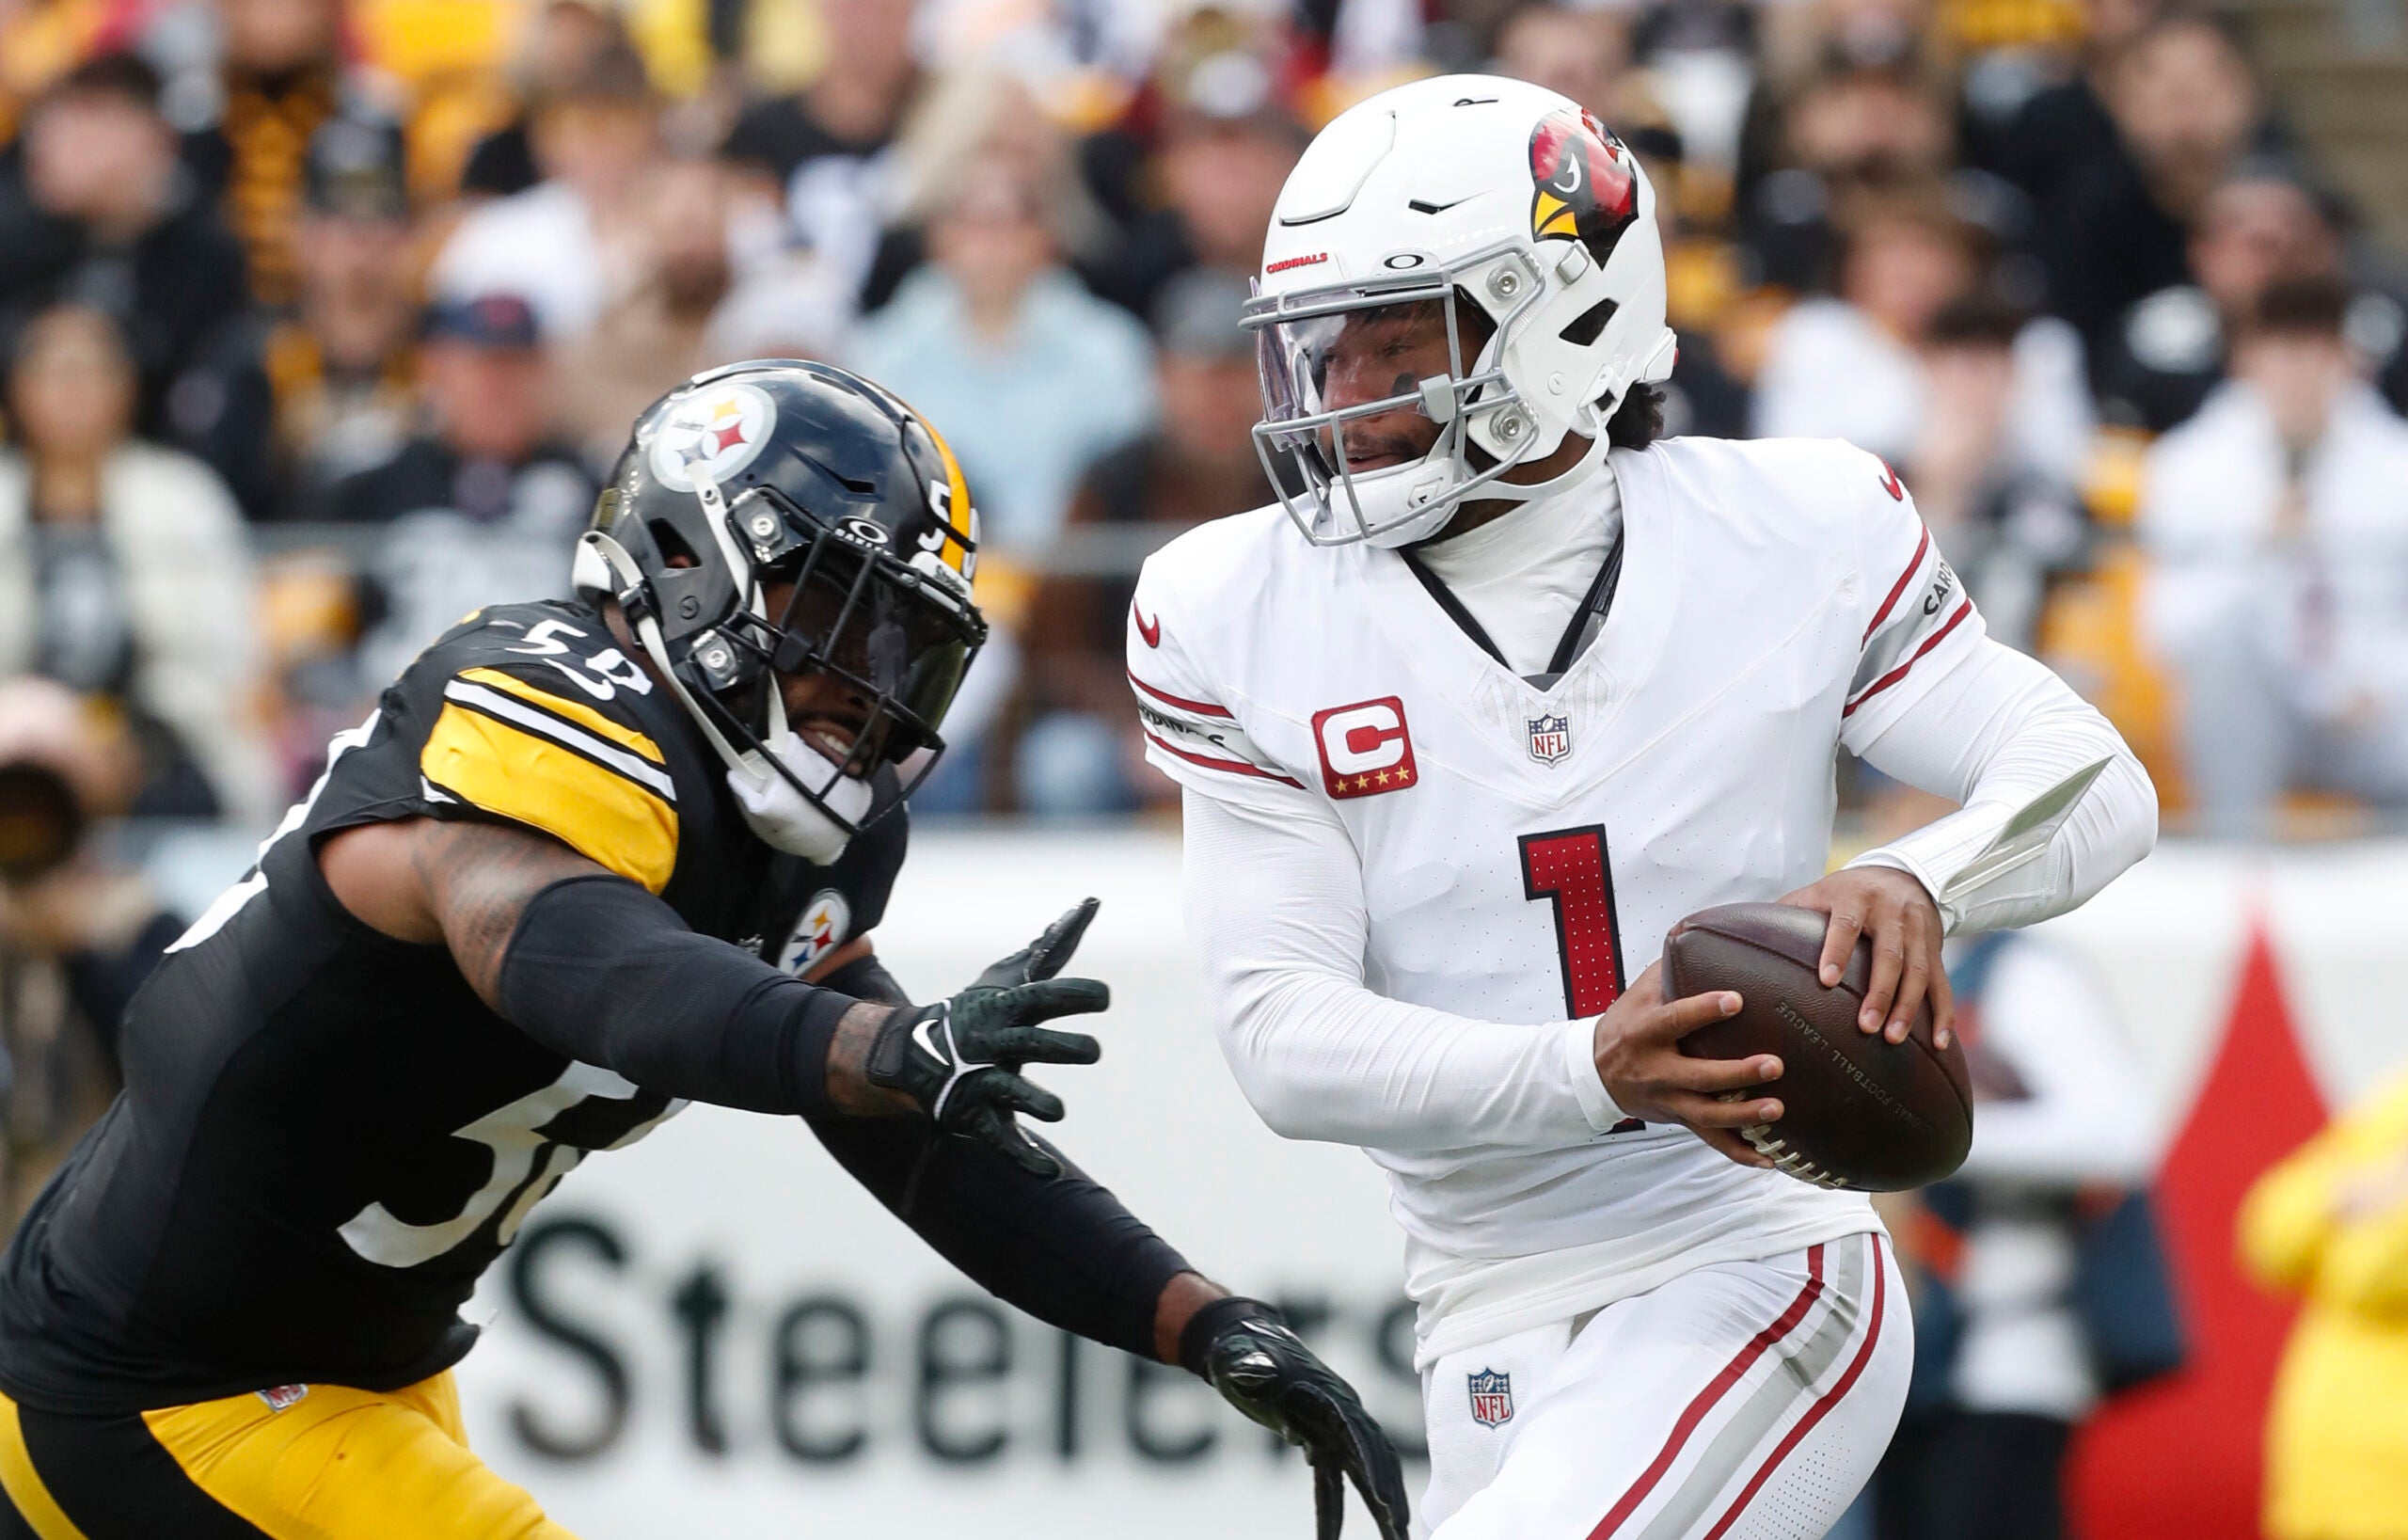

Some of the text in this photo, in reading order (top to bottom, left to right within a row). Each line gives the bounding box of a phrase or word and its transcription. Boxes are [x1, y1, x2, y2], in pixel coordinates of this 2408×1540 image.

[1266, 252, 1328, 275] CARDINALS
[1322, 704, 1405, 776] C
[1533, 734, 1567, 757] NFL
[1517, 822, 1647, 1136] 1
[1776, 1001, 1830, 1052] LEAGUE
[1830, 1048, 1893, 1106] FOOTBALL
[1474, 1395, 1511, 1423] NFL
